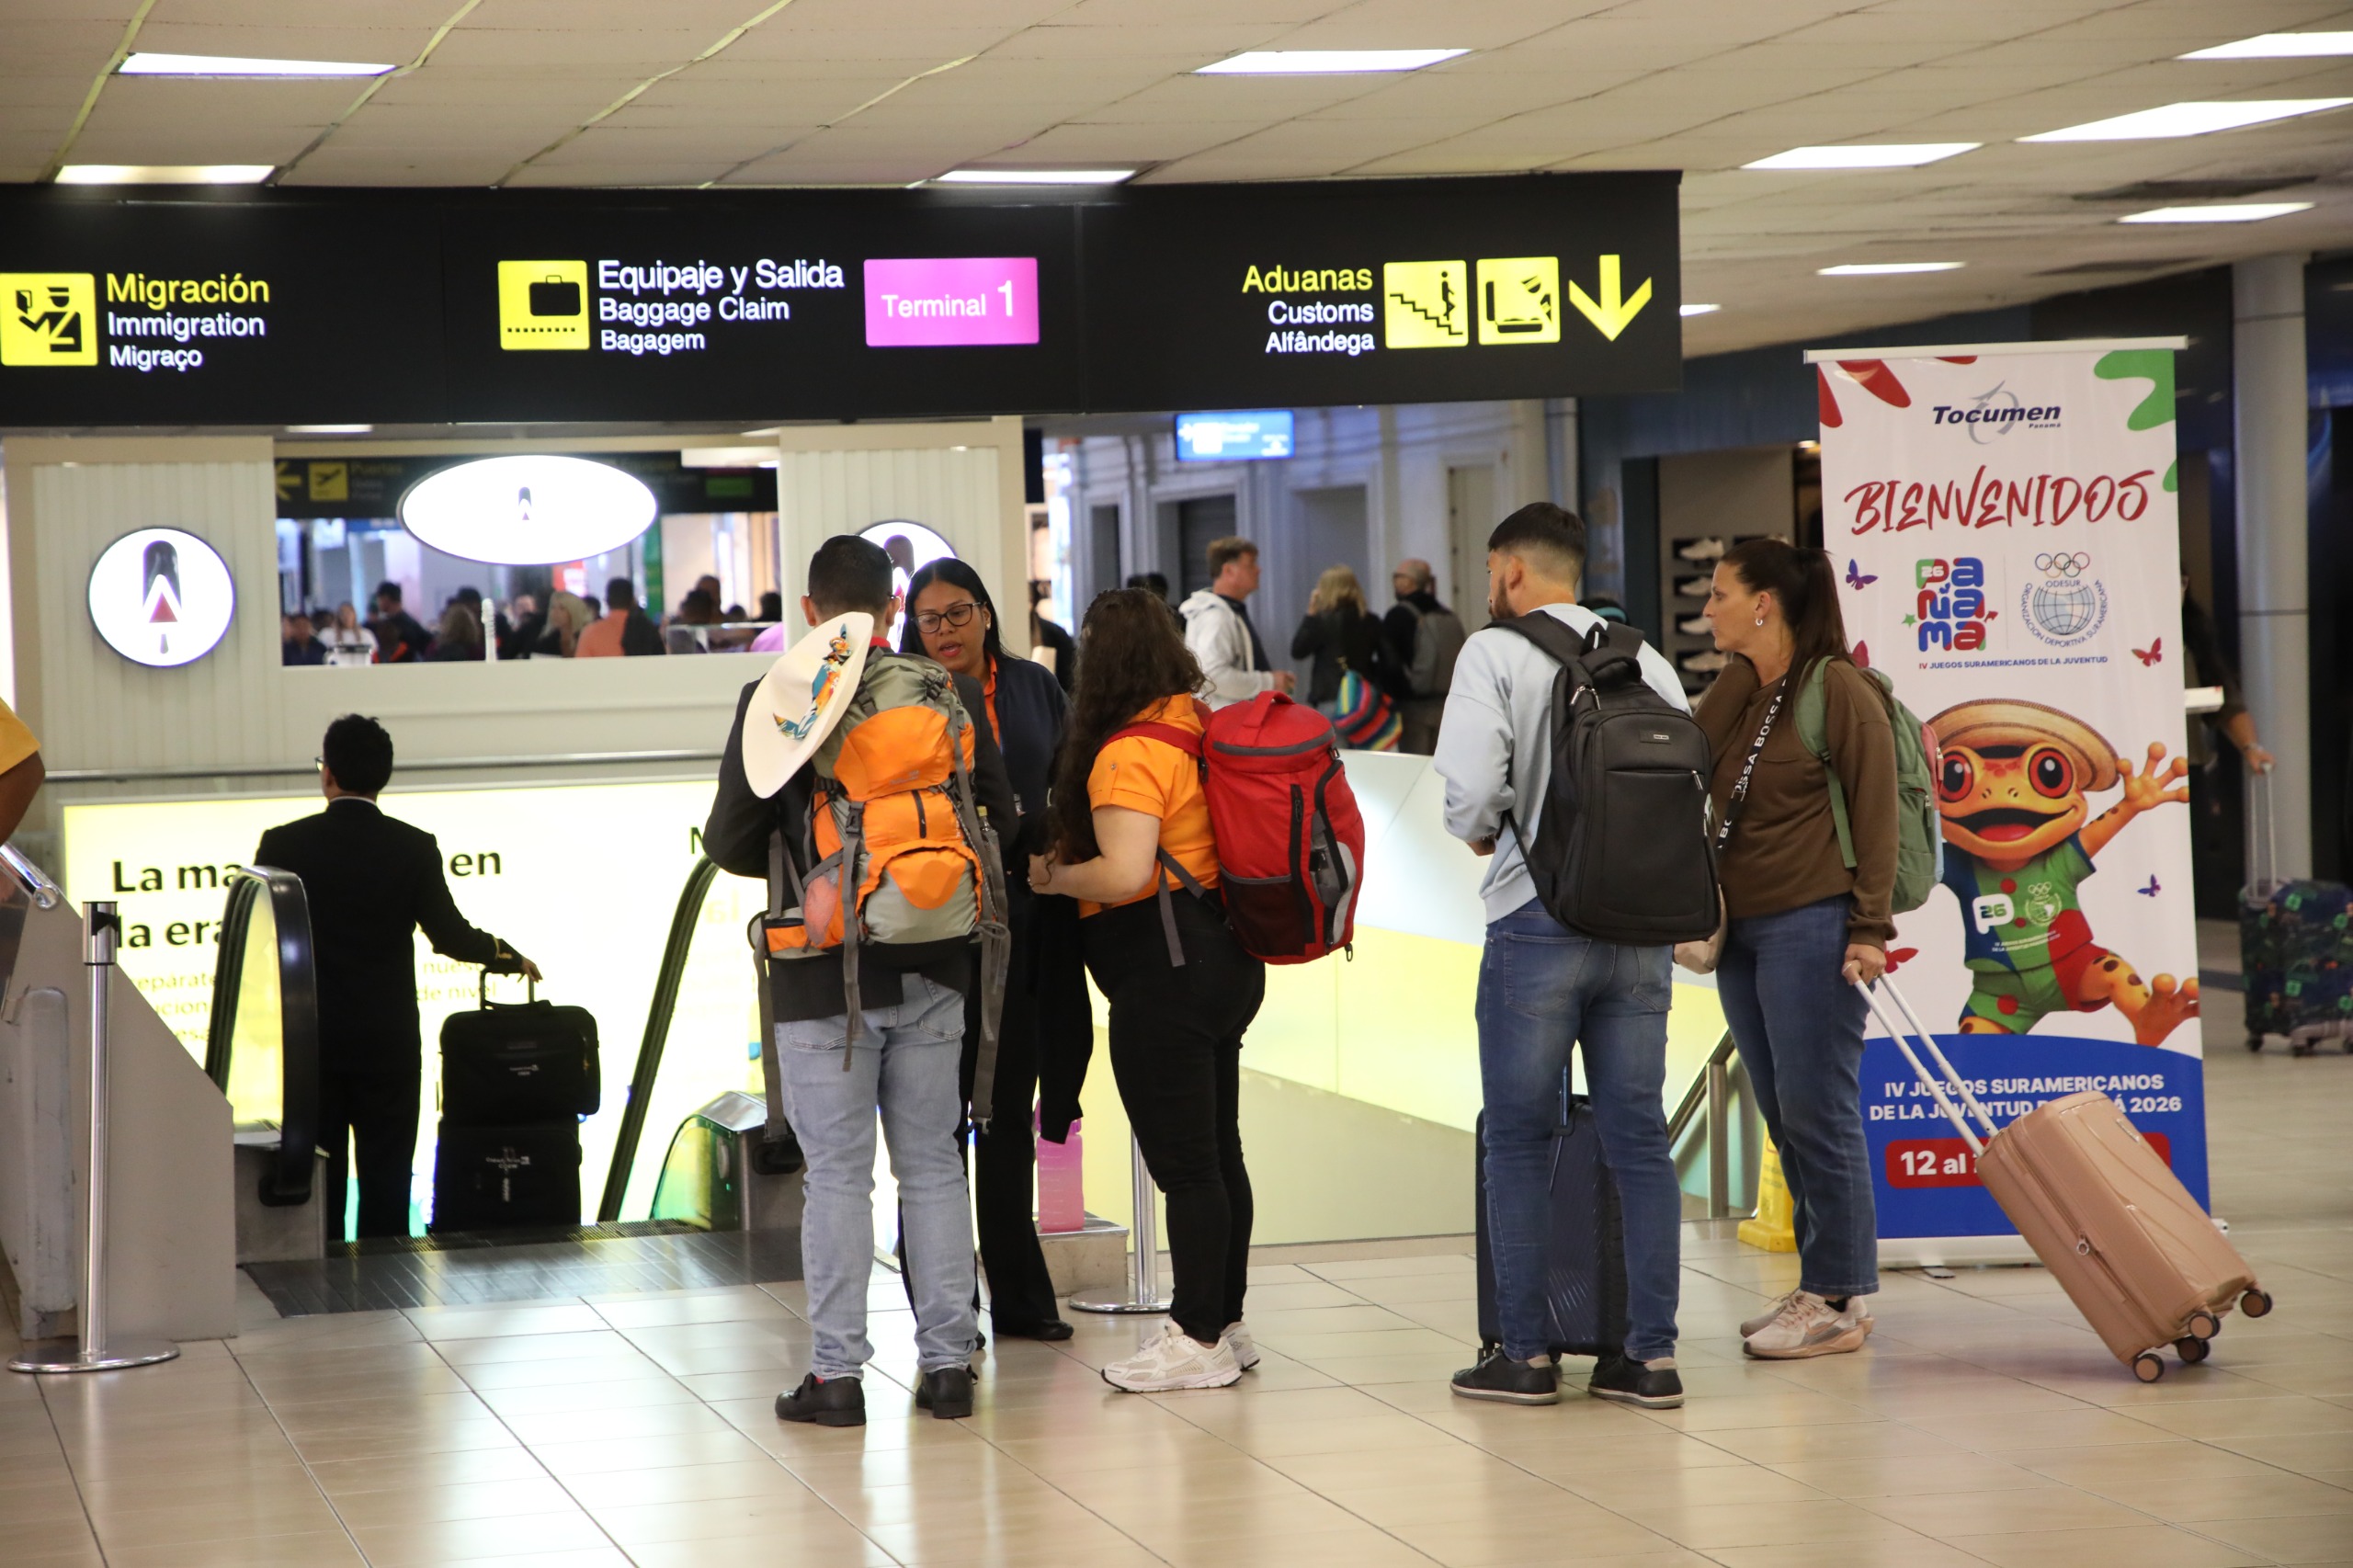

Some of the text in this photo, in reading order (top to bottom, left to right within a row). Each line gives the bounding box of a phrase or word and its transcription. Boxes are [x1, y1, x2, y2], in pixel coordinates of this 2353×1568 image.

[597, 258, 846, 296] Equipaje y Salida
[1242, 264, 1373, 294] Aduanas
[105, 272, 270, 311] Migración
[880, 278, 1016, 319] Terminal 1
[598, 296, 790, 327] Baggage Claim
[1267, 300, 1374, 326] Customs
[107, 312, 267, 342] Immigration
[600, 328, 706, 357] Bagagem
[1264, 329, 1376, 357] Alfândega
[108, 345, 204, 372] Migraço
[1932, 405, 2062, 424] Tocumen
[1844, 464, 2155, 536] BIENVENIDOS
[2045, 580, 2081, 588] ODESUR
[1963, 658, 2037, 668] SURAMERICANOS
[113, 861, 164, 892] La
[1980, 903, 2007, 919] 26
[1885, 1082, 1905, 1097] IV
[1991, 1074, 2165, 1095] SURAMERICANOS
[1870, 1105, 1895, 1120] DE
[1899, 1103, 1926, 1119] LA
[2130, 1096, 2183, 1113] 2026
[1900, 1150, 1938, 1176] 12
[1943, 1153, 1967, 1175] al
